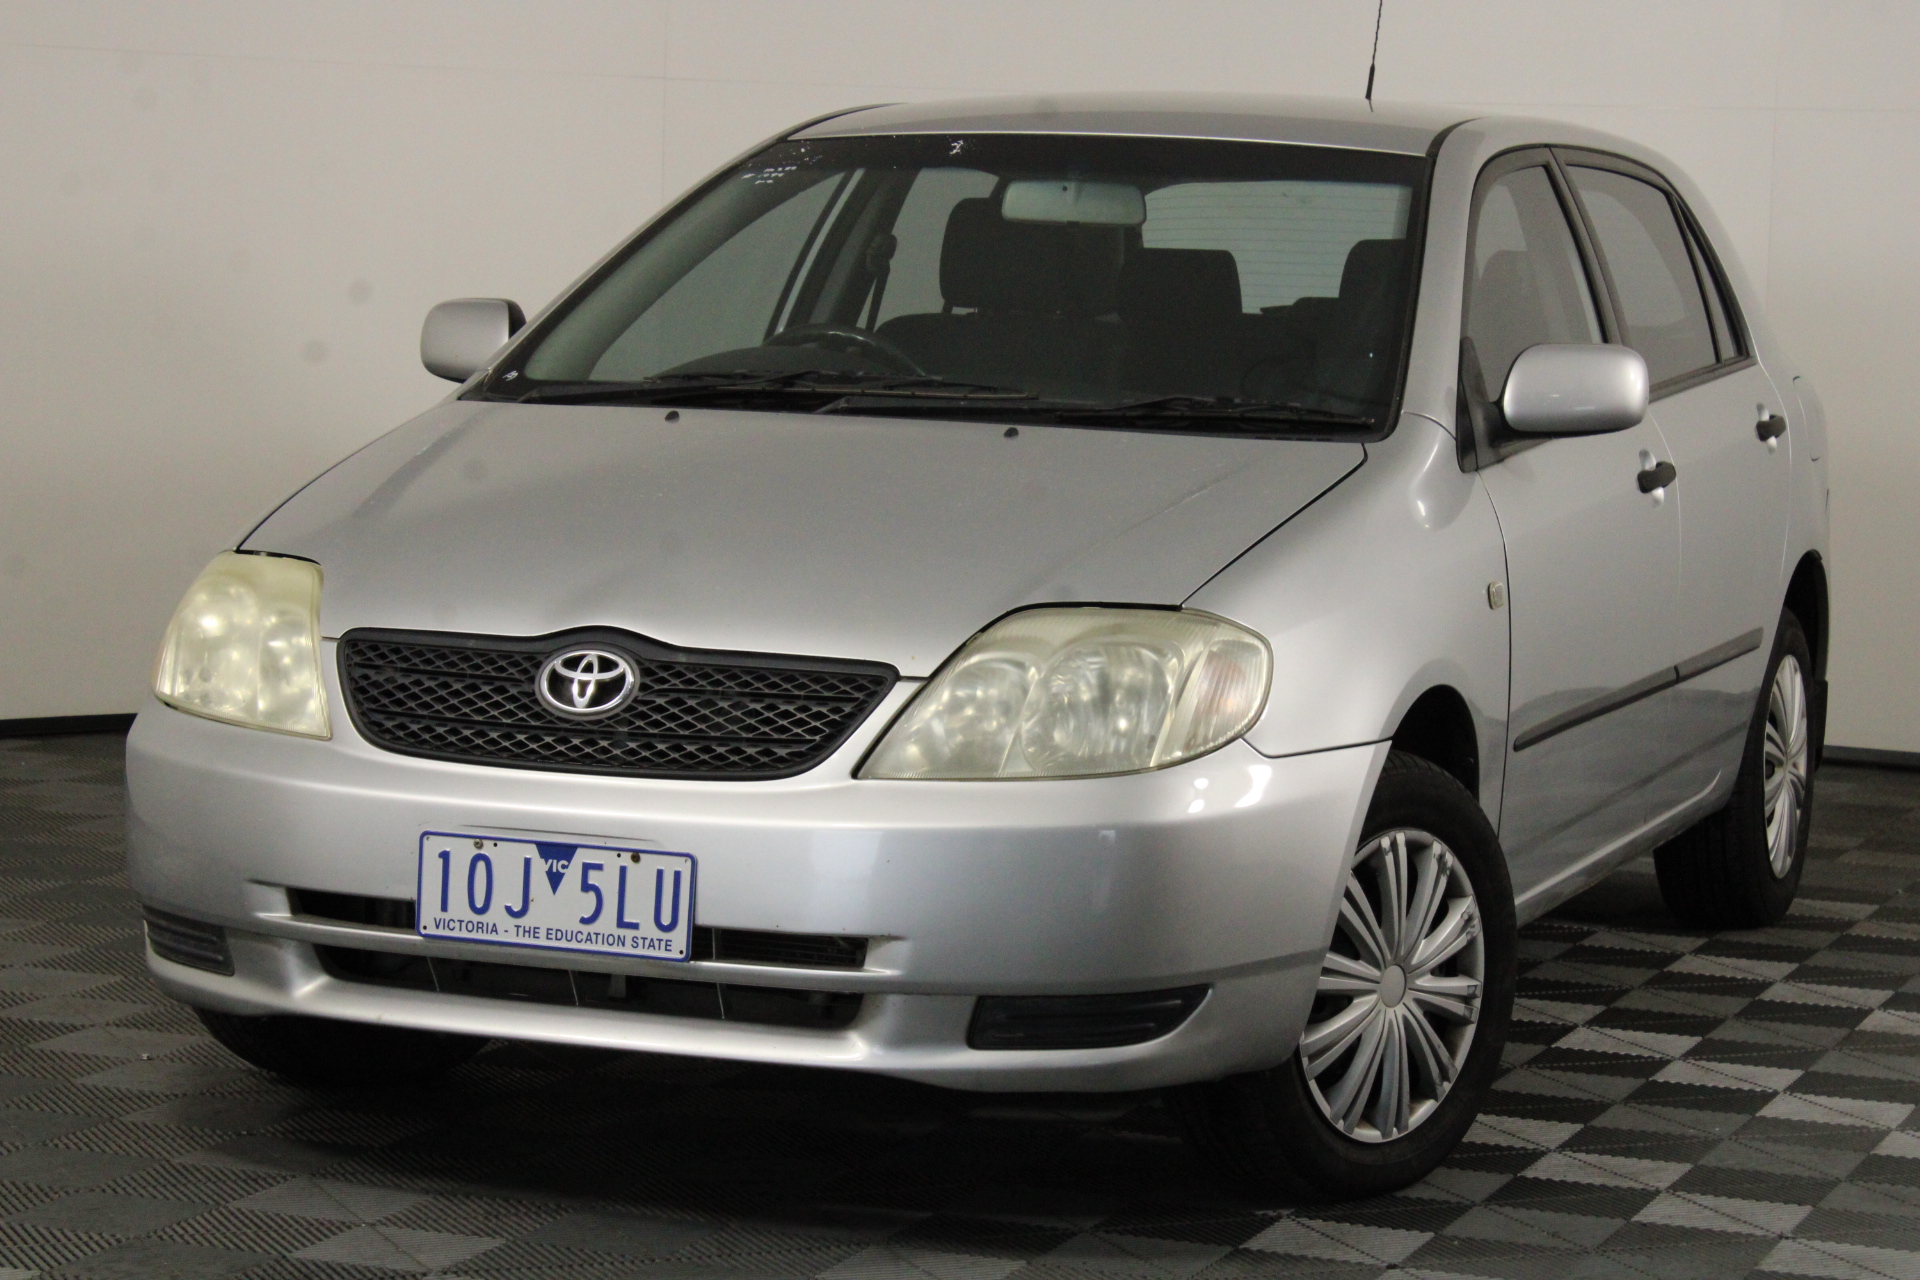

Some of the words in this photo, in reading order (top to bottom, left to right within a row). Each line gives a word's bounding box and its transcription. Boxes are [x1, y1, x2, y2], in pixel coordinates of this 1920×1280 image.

[544, 858, 569, 874] VIC
[579, 861, 682, 933] 5LU
[433, 917, 499, 936] VICTORIA
[514, 924, 541, 940] THE
[545, 928, 626, 948] EDUCATION
[631, 935, 673, 953] STATE
